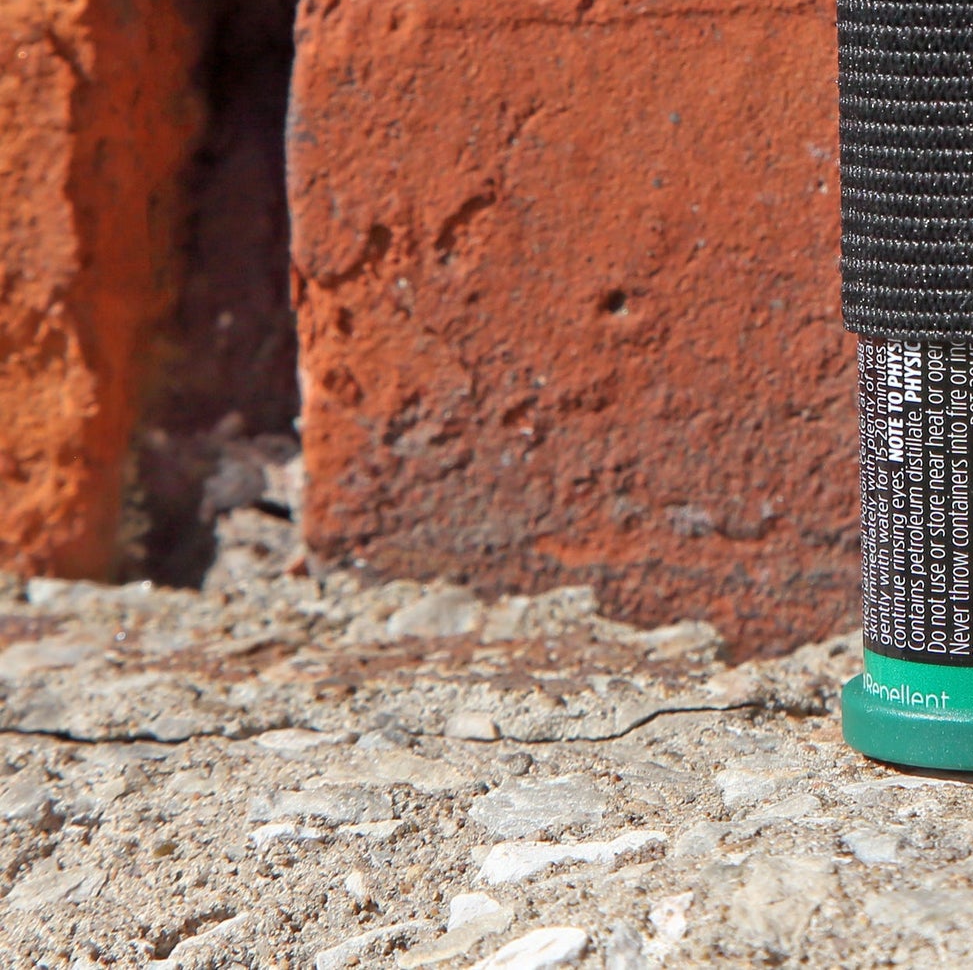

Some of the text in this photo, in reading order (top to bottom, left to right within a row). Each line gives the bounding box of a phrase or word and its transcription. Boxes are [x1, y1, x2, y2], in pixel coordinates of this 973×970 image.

[864, 372, 874, 392] of
[928, 386, 944, 404] or
[950, 366, 967, 385] or
[887, 391, 903, 413] TO
[946, 389, 967, 417] fire
[864, 396, 876, 452] plenty
[888, 416, 904, 463] NOTE
[924, 408, 944, 447] heat
[946, 422, 968, 454] into
[905, 408, 924, 482] distillate.
[865, 454, 876, 492] with
[891, 467, 907, 509] eyes.
[928, 450, 944, 490] near
[874, 342, 892, 646] gently with water for 15-20 minutes.
[946, 459, 969, 546] containers
[906, 486, 927, 575] petroleum
[926, 494, 946, 537] store
[866, 496, 878, 604] immediately
[890, 513, 908, 571] rinsing
[929, 540, 946, 560] or
[929, 563, 946, 593] use
[948, 551, 969, 601] throw
[868, 607, 878, 642] skin
[890, 575, 906, 648] continue
[907, 579, 926, 651] Contains
[927, 598, 946, 626] not
[949, 605, 970, 655] Never
[926, 630, 947, 653] Do
